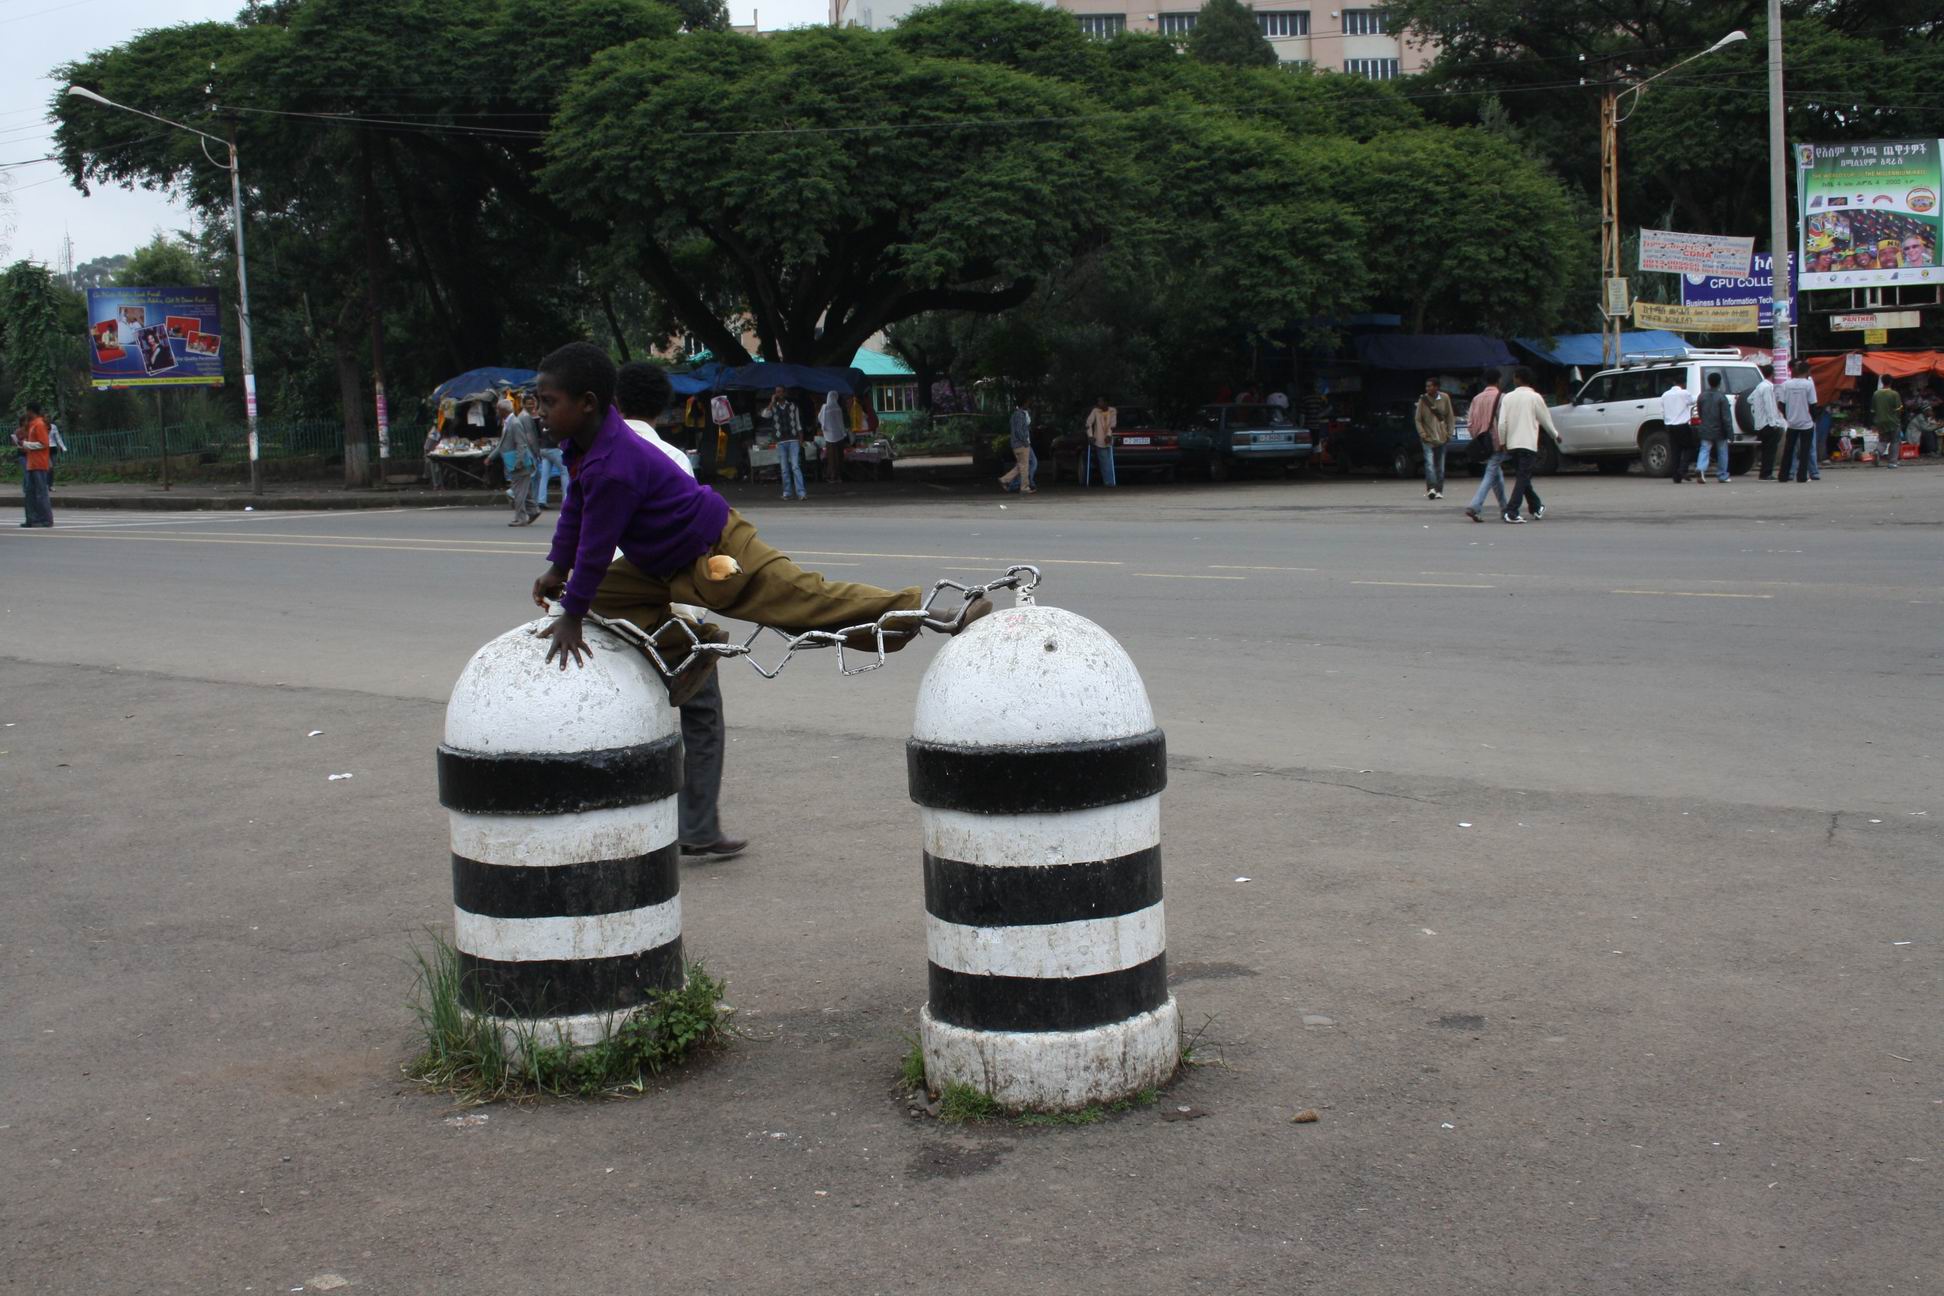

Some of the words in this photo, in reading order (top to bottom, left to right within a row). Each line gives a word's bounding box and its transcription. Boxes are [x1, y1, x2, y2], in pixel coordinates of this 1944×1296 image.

[1683, 250, 1712, 259] CDMA
[1710, 279, 1734, 288] CPU
[1686, 299, 1714, 307] Business
[1722, 297, 1757, 305] Information
